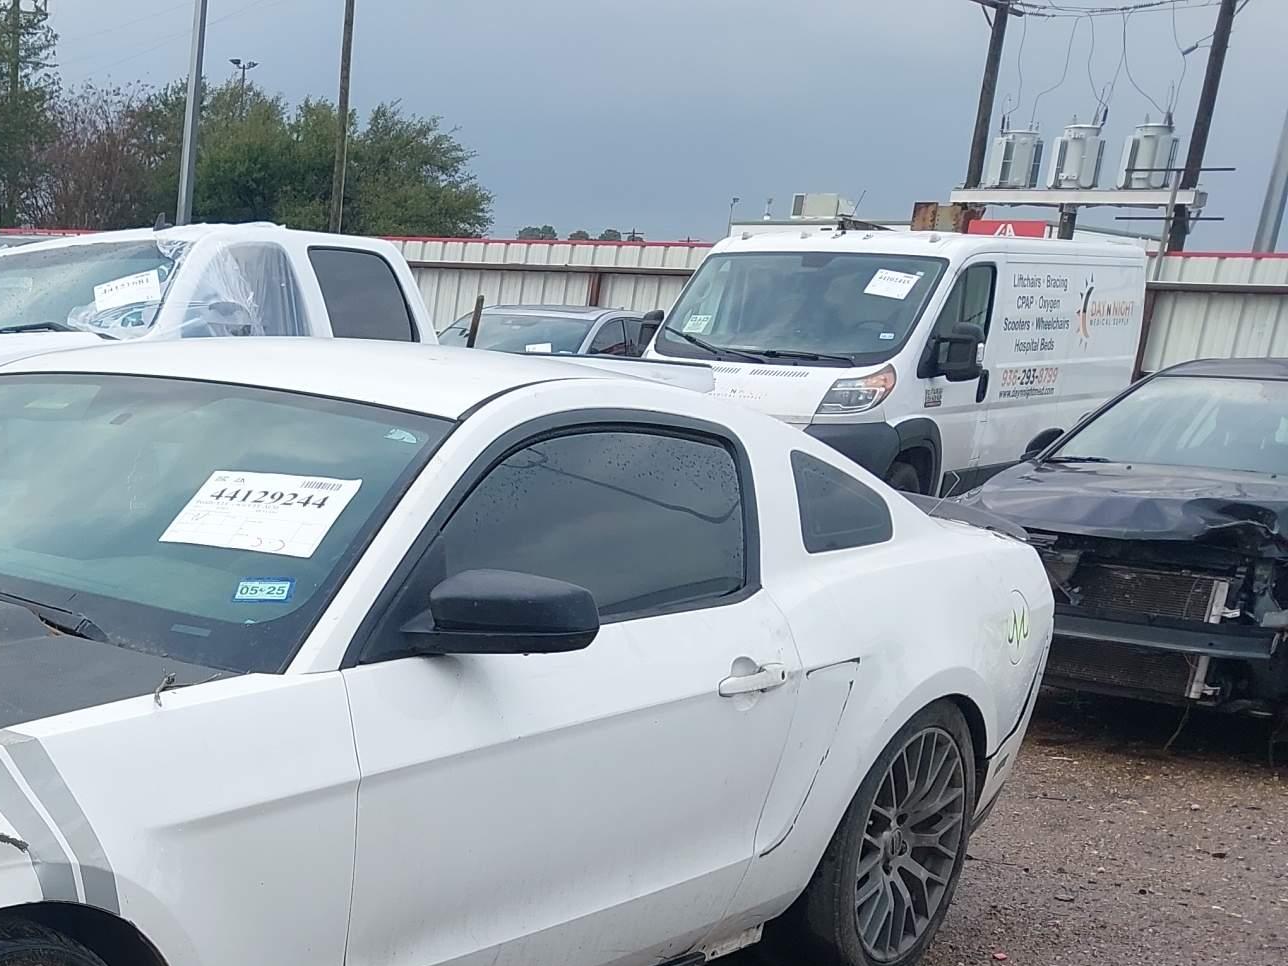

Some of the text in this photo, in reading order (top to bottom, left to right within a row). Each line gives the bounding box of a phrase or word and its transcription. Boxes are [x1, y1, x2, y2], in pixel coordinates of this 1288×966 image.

[1013, 273, 1068, 292] Liftchairs Bracing
[1016, 295, 1061, 313] CPAP Oxygen
[1003, 316, 1070, 331] Scooters Wheelchairs
[1014, 337, 1055, 355] Hospital Beds
[1001, 367, 1058, 387] 936-293-8799
[209, 487, 330, 509] 44129244
[239, 585, 286, 595] 05 25
